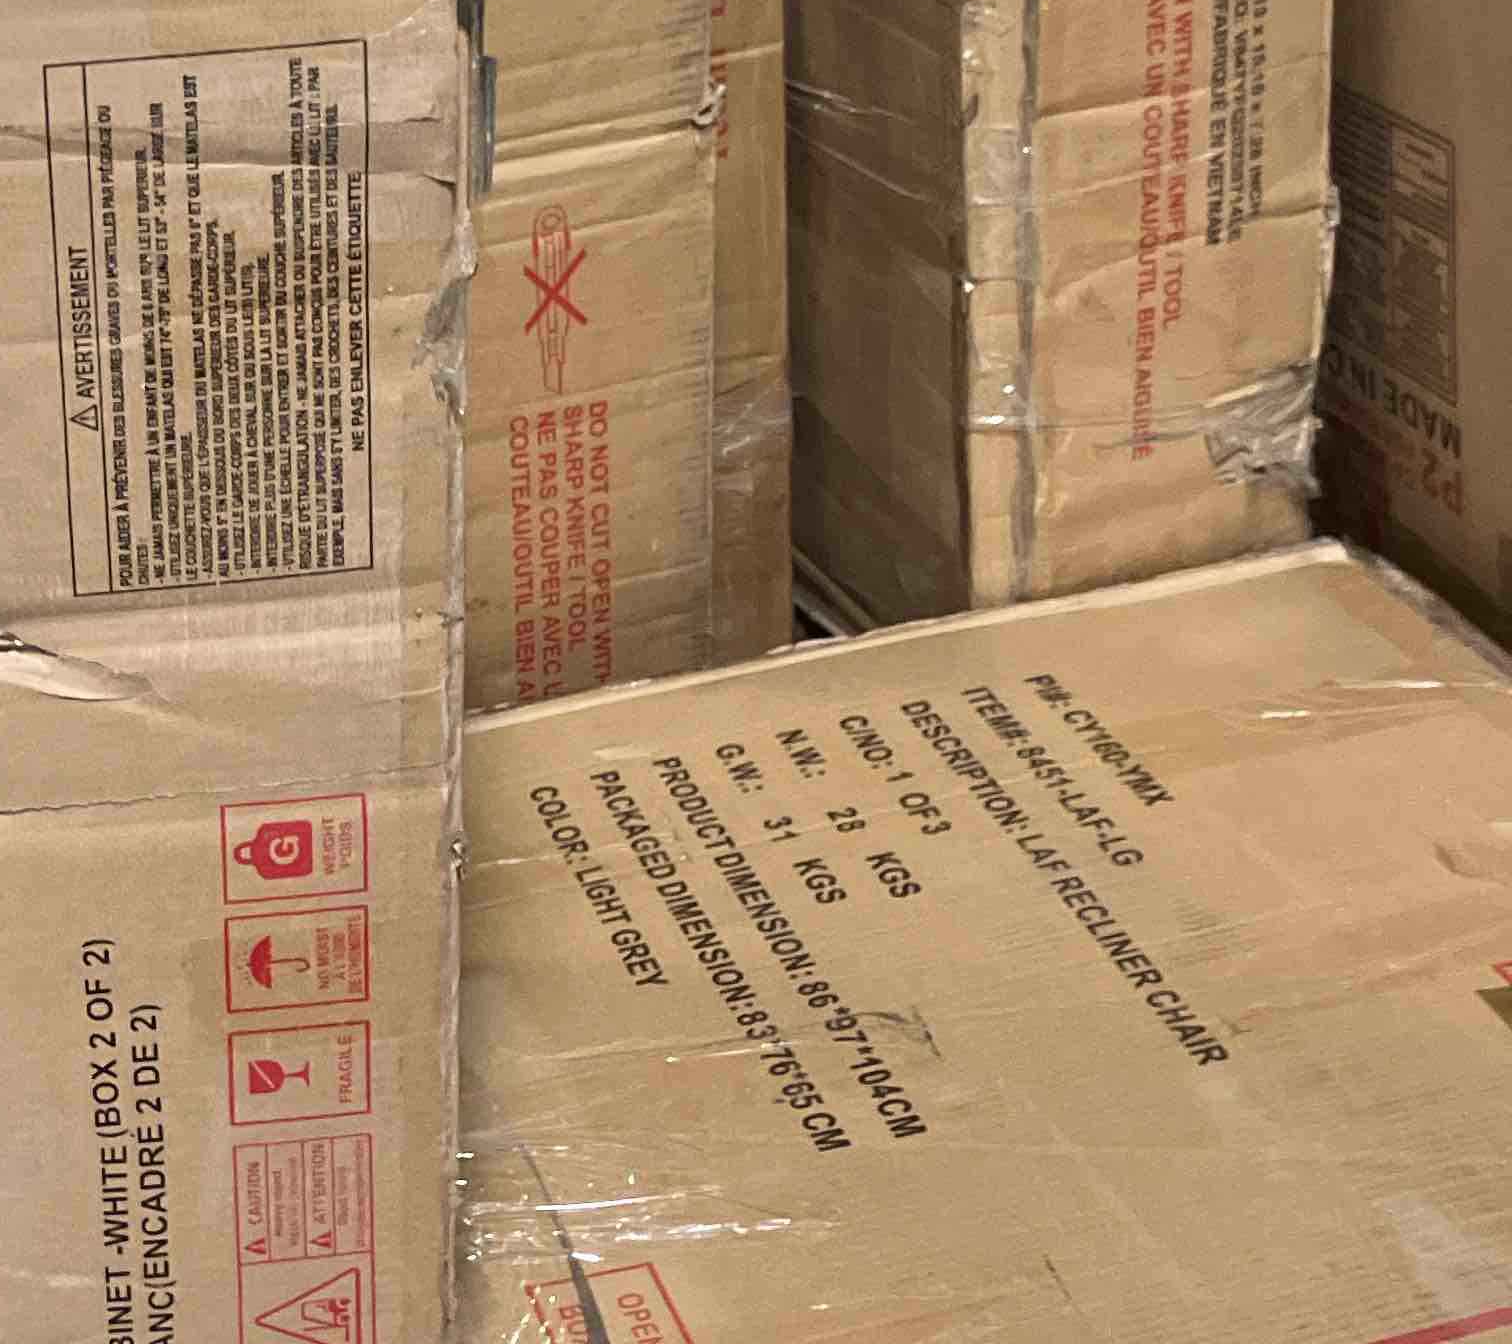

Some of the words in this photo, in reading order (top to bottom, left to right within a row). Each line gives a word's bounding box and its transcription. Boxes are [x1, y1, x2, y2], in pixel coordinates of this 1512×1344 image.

[1173, 10, 1194, 77] WITH
[1144, 63, 1166, 99] UN
[344, 172, 362, 259] ÉTIQUETTE
[1205, 154, 1225, 246] VIETNAM
[348, 265, 362, 314] CETTE
[1161, 265, 1185, 331] TOOL
[68, 244, 94, 399] AVERTISSEMENT
[1134, 305, 1157, 362] BIEN
[349, 320, 363, 392] ENLEVER
[351, 396, 364, 425] PAS
[352, 429, 364, 451] NE
[537, 410, 556, 445] NE
[589, 398, 607, 438] DO
[537, 451, 558, 499] PAS
[563, 403, 584, 490] SHARP
[589, 444, 608, 496] NOT
[509, 413, 533, 612] COUTEAU/OUTIL
[566, 495, 586, 569] KNIFE
[590, 502, 608, 551] CUT
[539, 505, 560, 609] COUPER
[568, 591, 586, 648] TOOL
[591, 557, 609, 624] OPEN
[515, 618, 535, 673] BIEN
[542, 615, 561, 674] AVEC
[839, 715, 894, 770] C/NO:
[885, 771, 915, 783] 1
[960, 685, 1031, 748] ITEM#:
[1015, 745, 1145, 867] 8451-LAF-LG
[715, 743, 764, 794] G.W.:
[763, 815, 801, 843] 31
[791, 857, 848, 905] KGS
[775, 728, 827, 779] N.W.:
[825, 806, 867, 833] 28
[864, 851, 923, 899] KGS
[898, 792, 942, 820] OF
[920, 820, 953, 836] 3
[529, 785, 590, 865] COLOR:
[574, 865, 633, 925] LIGHT
[610, 928, 670, 987] GREY
[651, 756, 737, 850] PRODUCT
[713, 851, 817, 980] DIMENSION:
[900, 700, 1030, 835] DESCRIPTION:
[1015, 833, 1072, 872] LAF
[1049, 875, 1164, 990] RECLINER
[1145, 990, 1229, 1067] CHAIR
[79, 936, 116, 966] 2)
[589, 770, 677, 880] PACKAGED
[655, 880, 757, 1012] DIMENSION:
[801, 1112, 852, 1153] CM
[83, 977, 113, 1021] OF
[128, 1002, 164, 1032] 2)
[87, 1030, 114, 1049] 2
[131, 1042, 161, 1087] DE
[336, 1033, 354, 1104] FRAGILE
[89, 1058, 128, 1138] (BOX
[135, 1095, 162, 1114] 2
[245, 1160, 262, 1225] CAUTION
[310, 1142, 327, 1224] ATTENTION
